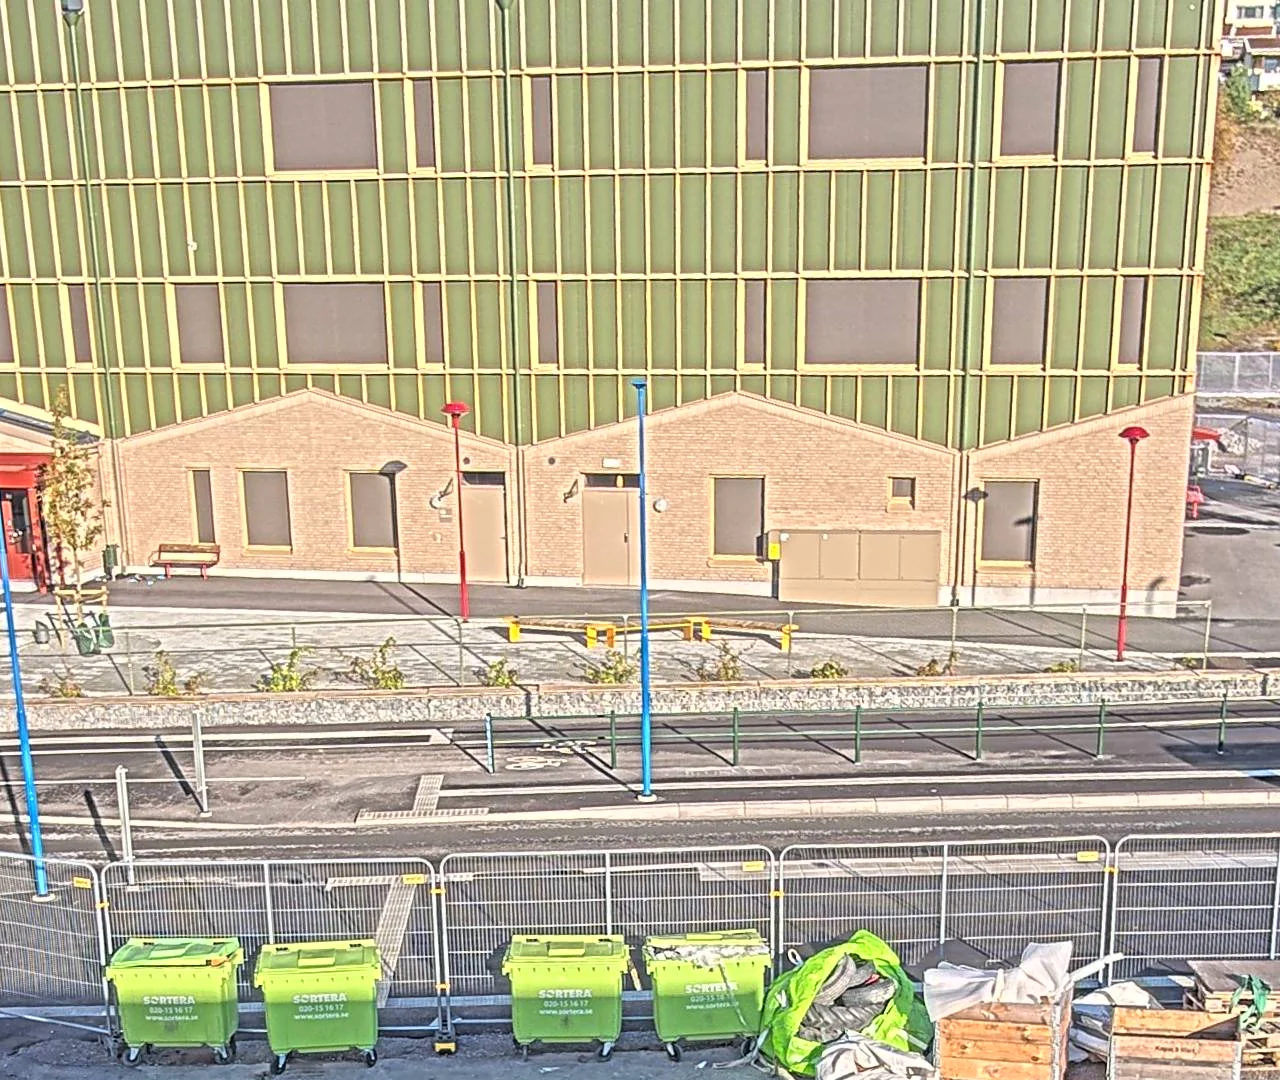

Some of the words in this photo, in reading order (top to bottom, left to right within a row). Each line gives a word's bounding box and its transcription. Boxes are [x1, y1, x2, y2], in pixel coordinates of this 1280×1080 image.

[293, 992, 348, 1004] SORTERA
[538, 988, 593, 999] SORTERA
[143, 995, 196, 1005] SORTERA
